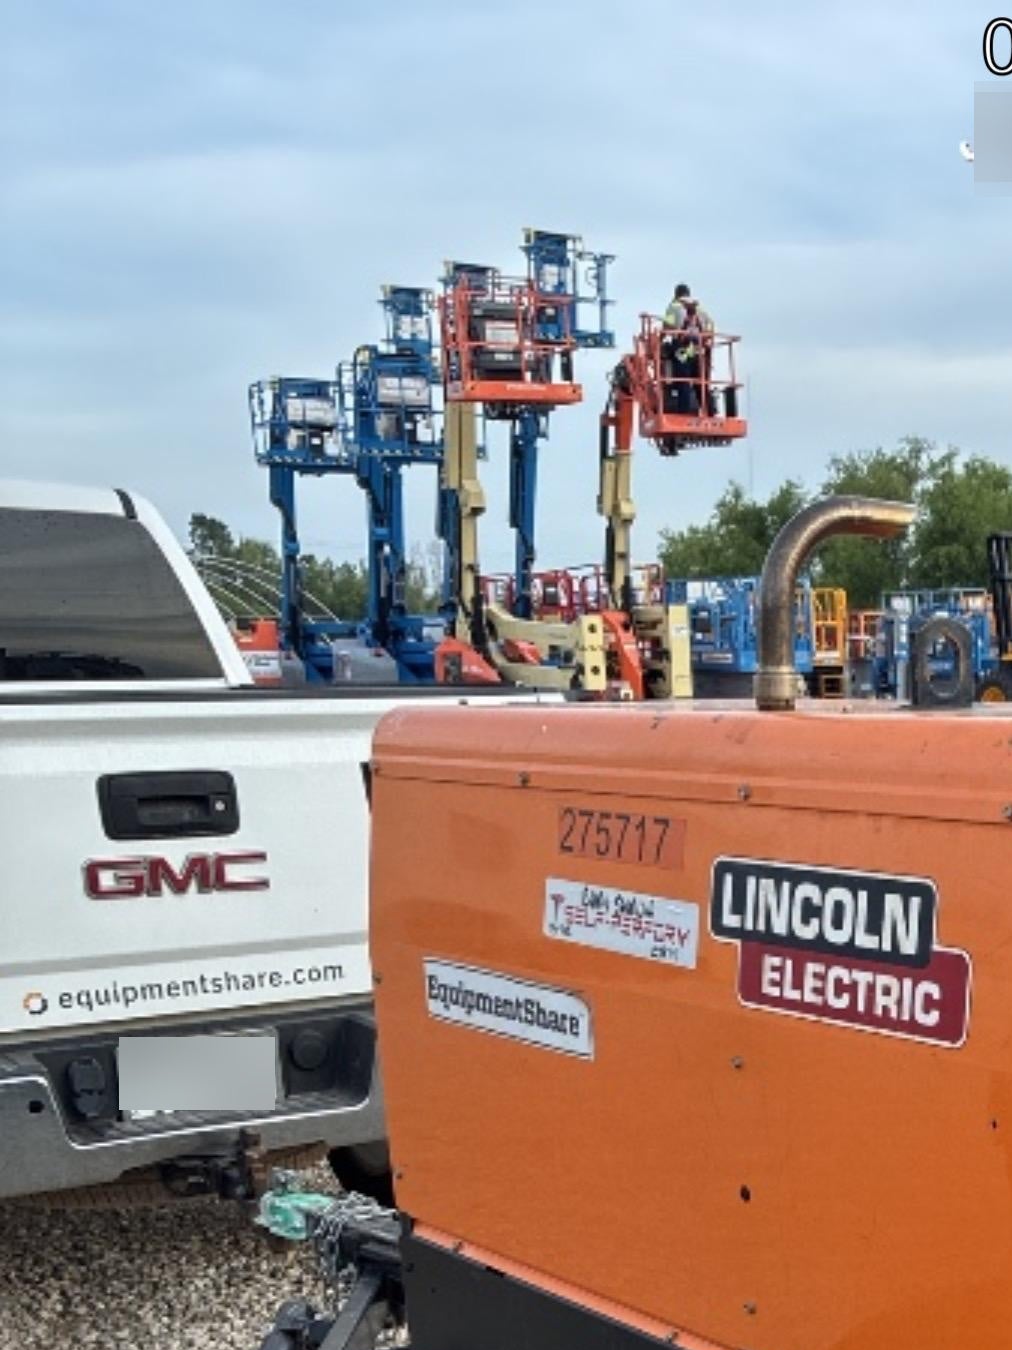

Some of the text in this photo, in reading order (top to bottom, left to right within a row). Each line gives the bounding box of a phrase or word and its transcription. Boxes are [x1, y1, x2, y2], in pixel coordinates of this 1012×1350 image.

[559, 806, 670, 864] 275717
[82, 850, 271, 901] GMC
[721, 872, 922, 956] LINCOLN
[58, 961, 345, 1012] equipmentshare.com
[427, 974, 580, 1038] EquipmentShare
[761, 954, 942, 1027] ELECTRIC
